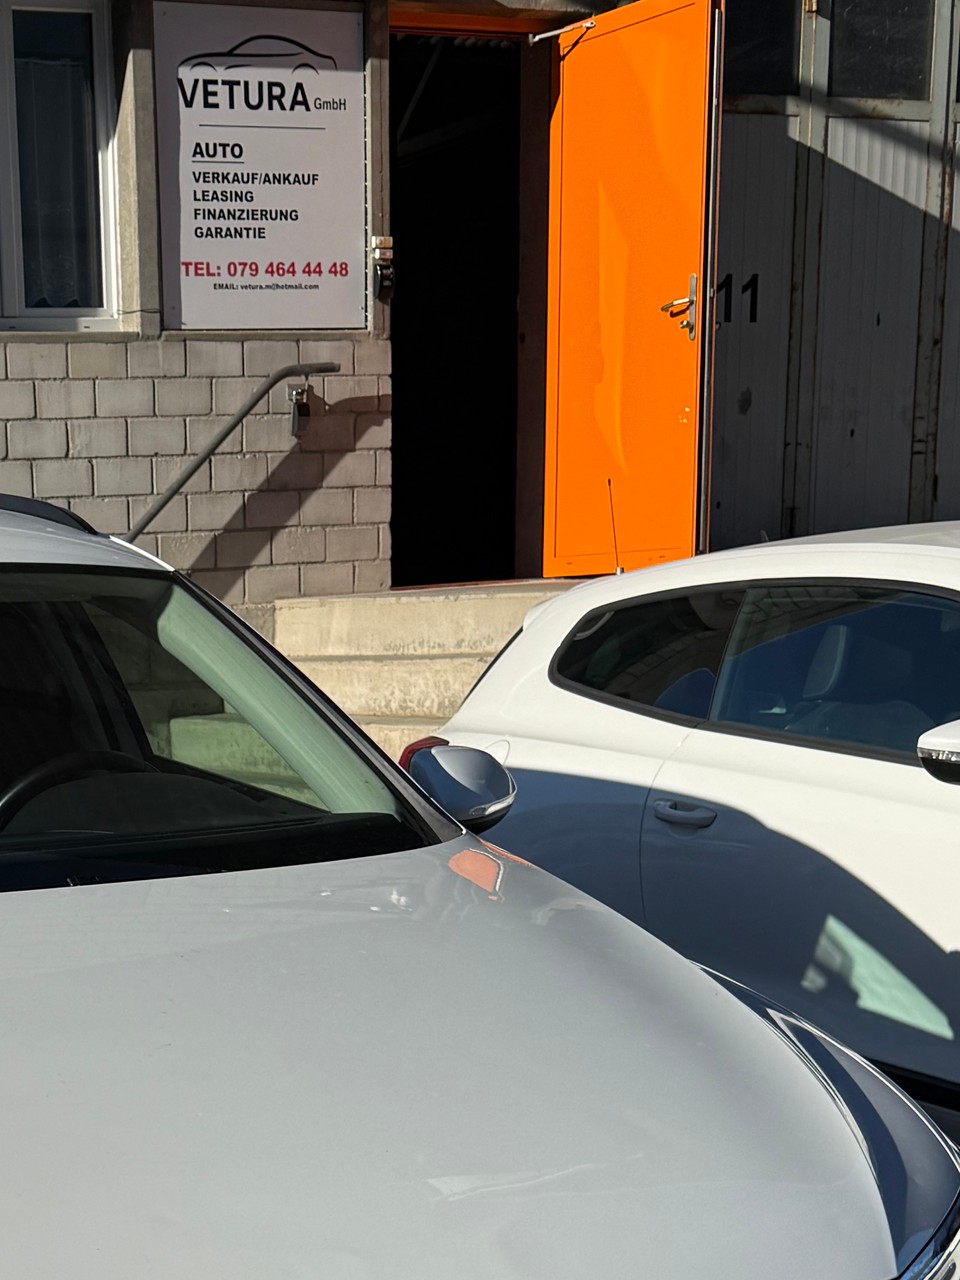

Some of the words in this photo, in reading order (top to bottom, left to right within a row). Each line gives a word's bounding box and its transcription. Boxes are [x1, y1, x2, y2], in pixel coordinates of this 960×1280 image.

[176, 77, 311, 112] VETURA
[313, 97, 347, 111] GmbH
[192, 142, 244, 159] AUTO
[192, 171, 319, 186] VERKAUF/ANKAUF
[193, 189, 254, 203] LEASING
[193, 208, 299, 222] FINANZIERUNG
[194, 226, 266, 239] GARANTIE
[181, 261, 222, 277] TEL:
[227, 261, 259, 277] 079
[264, 261, 297, 277] 464
[302, 261, 323, 277] 44
[328, 261, 349, 277] 48
[716, 273, 759, 323] 11
